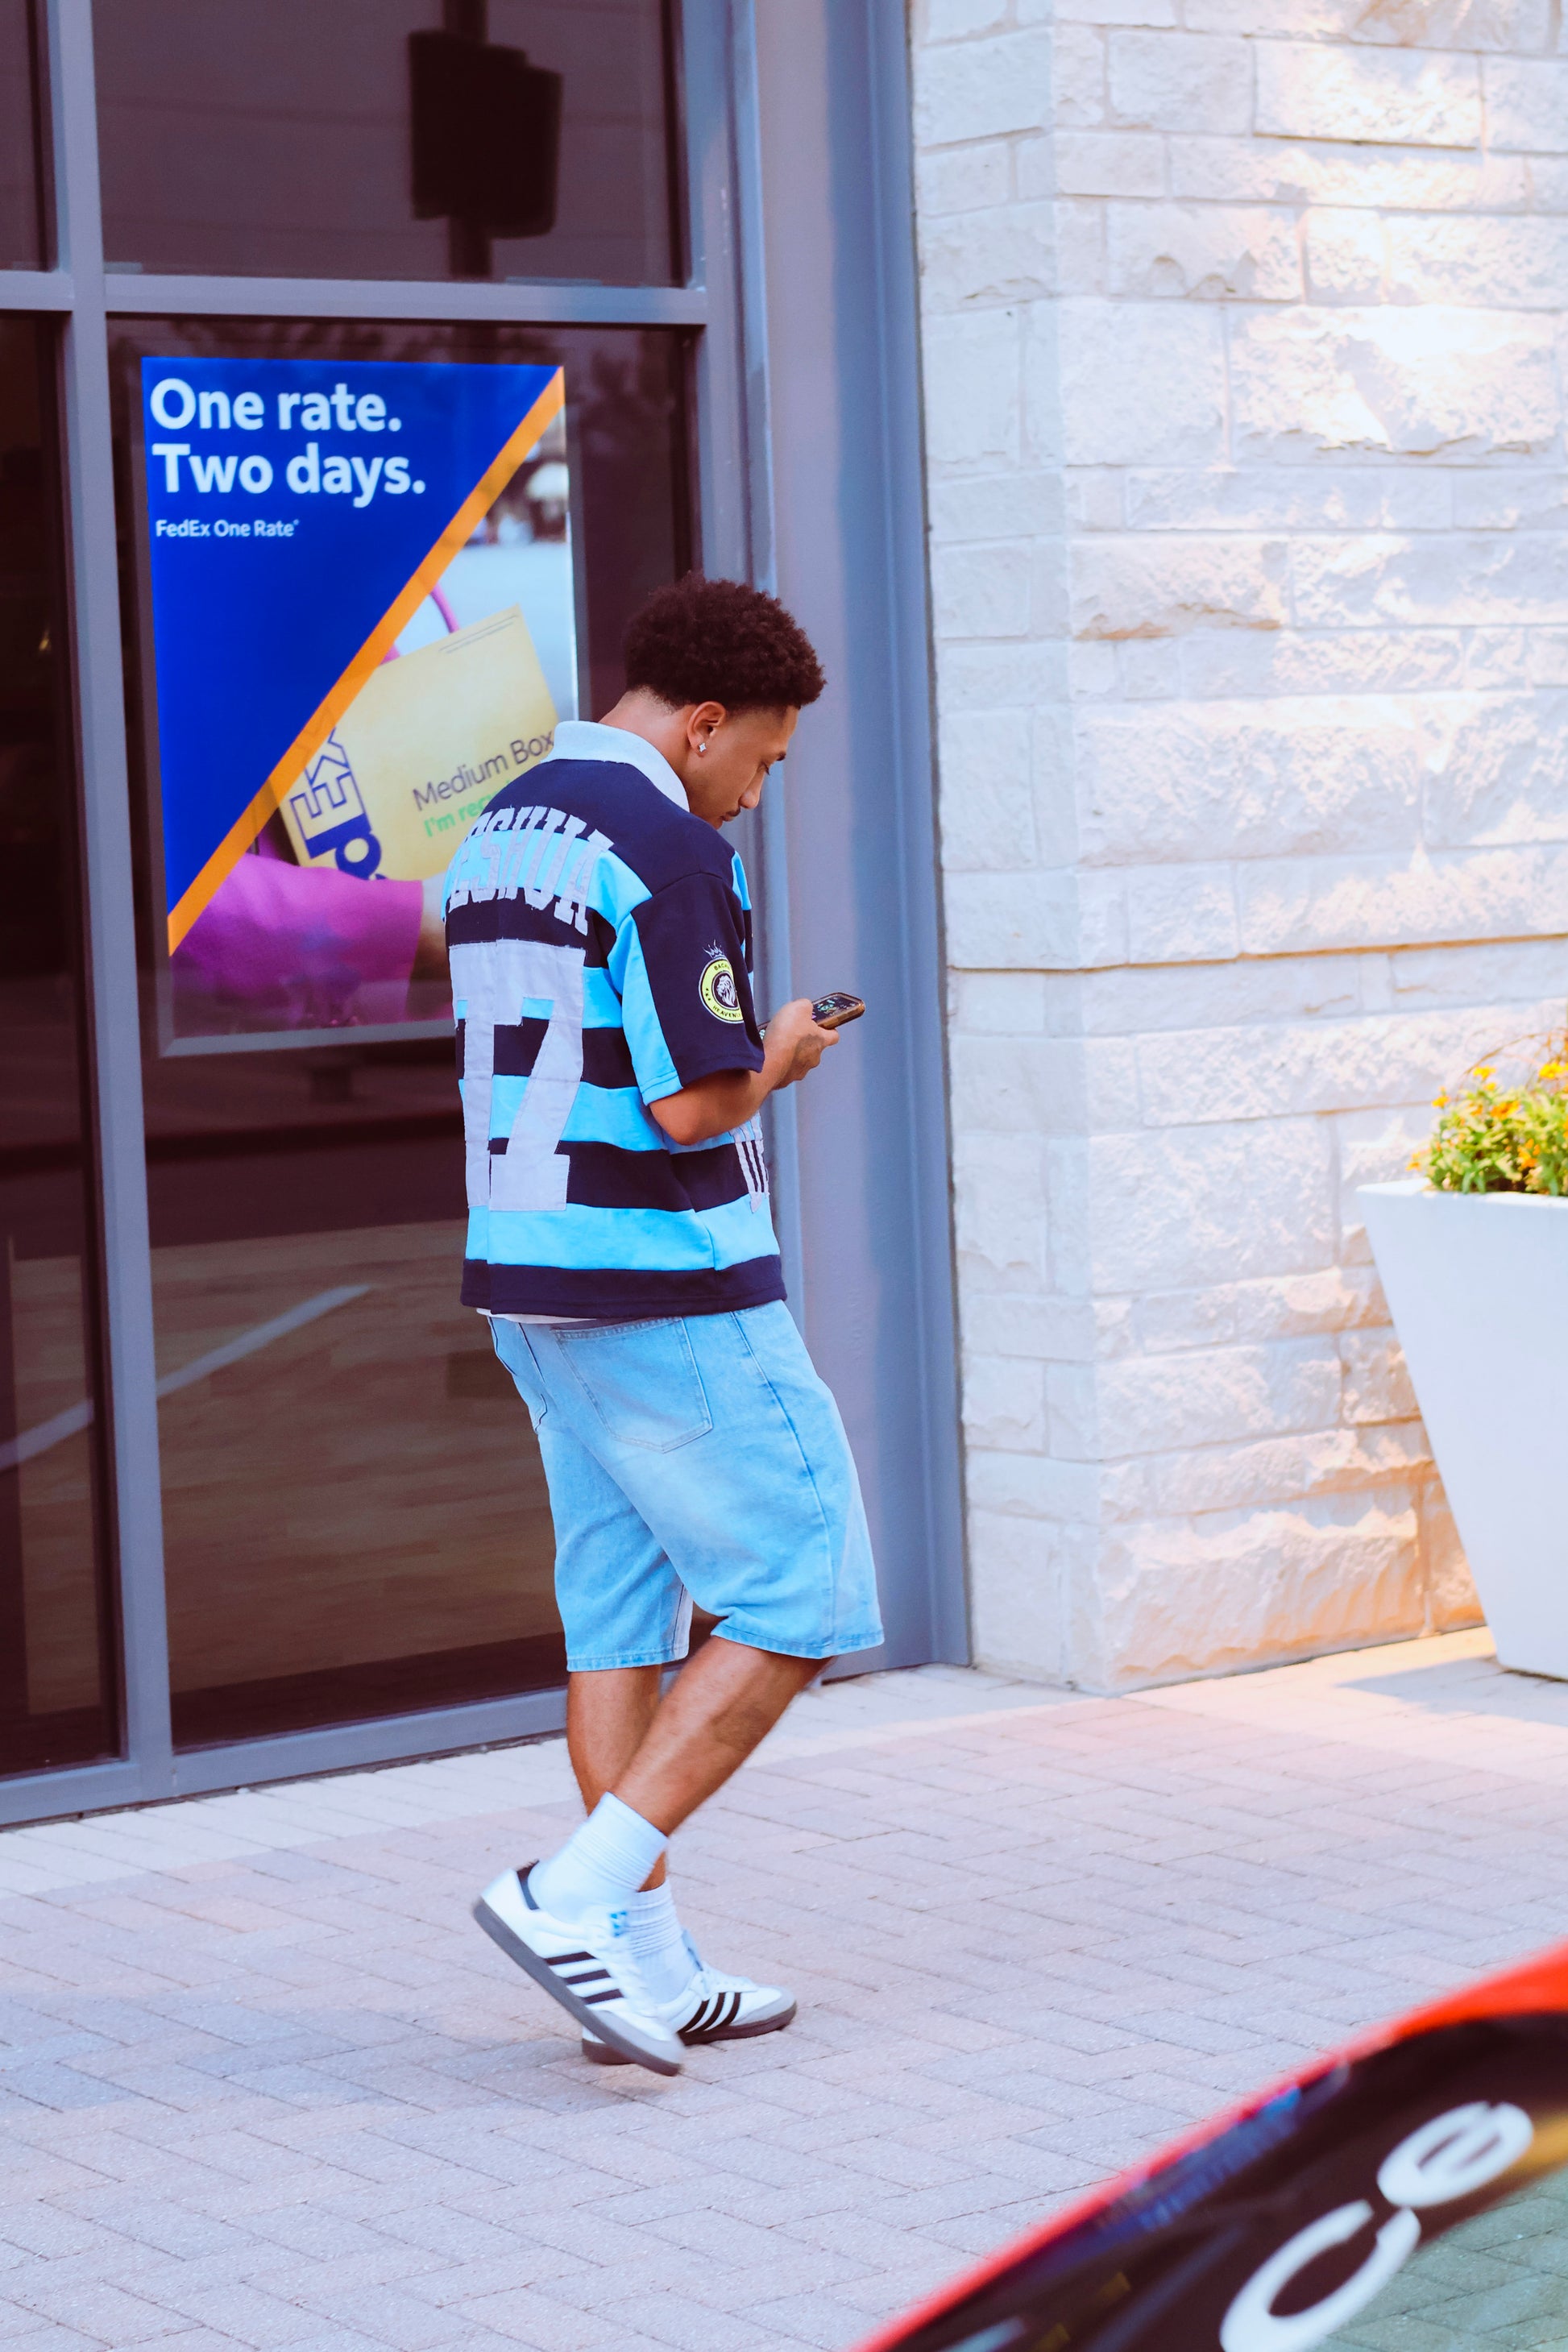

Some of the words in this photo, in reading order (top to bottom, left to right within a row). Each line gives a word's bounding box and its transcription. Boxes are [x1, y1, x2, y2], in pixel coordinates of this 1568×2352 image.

[151, 378, 264, 430] One
[277, 383, 402, 432] rate.
[151, 442, 273, 494] Two
[286, 442, 425, 508] days.
[156, 519, 210, 537] FedEx
[214, 519, 251, 537] One
[412, 753, 509, 811] Medium
[509, 730, 554, 765] Box
[424, 813, 456, 838] I'm
